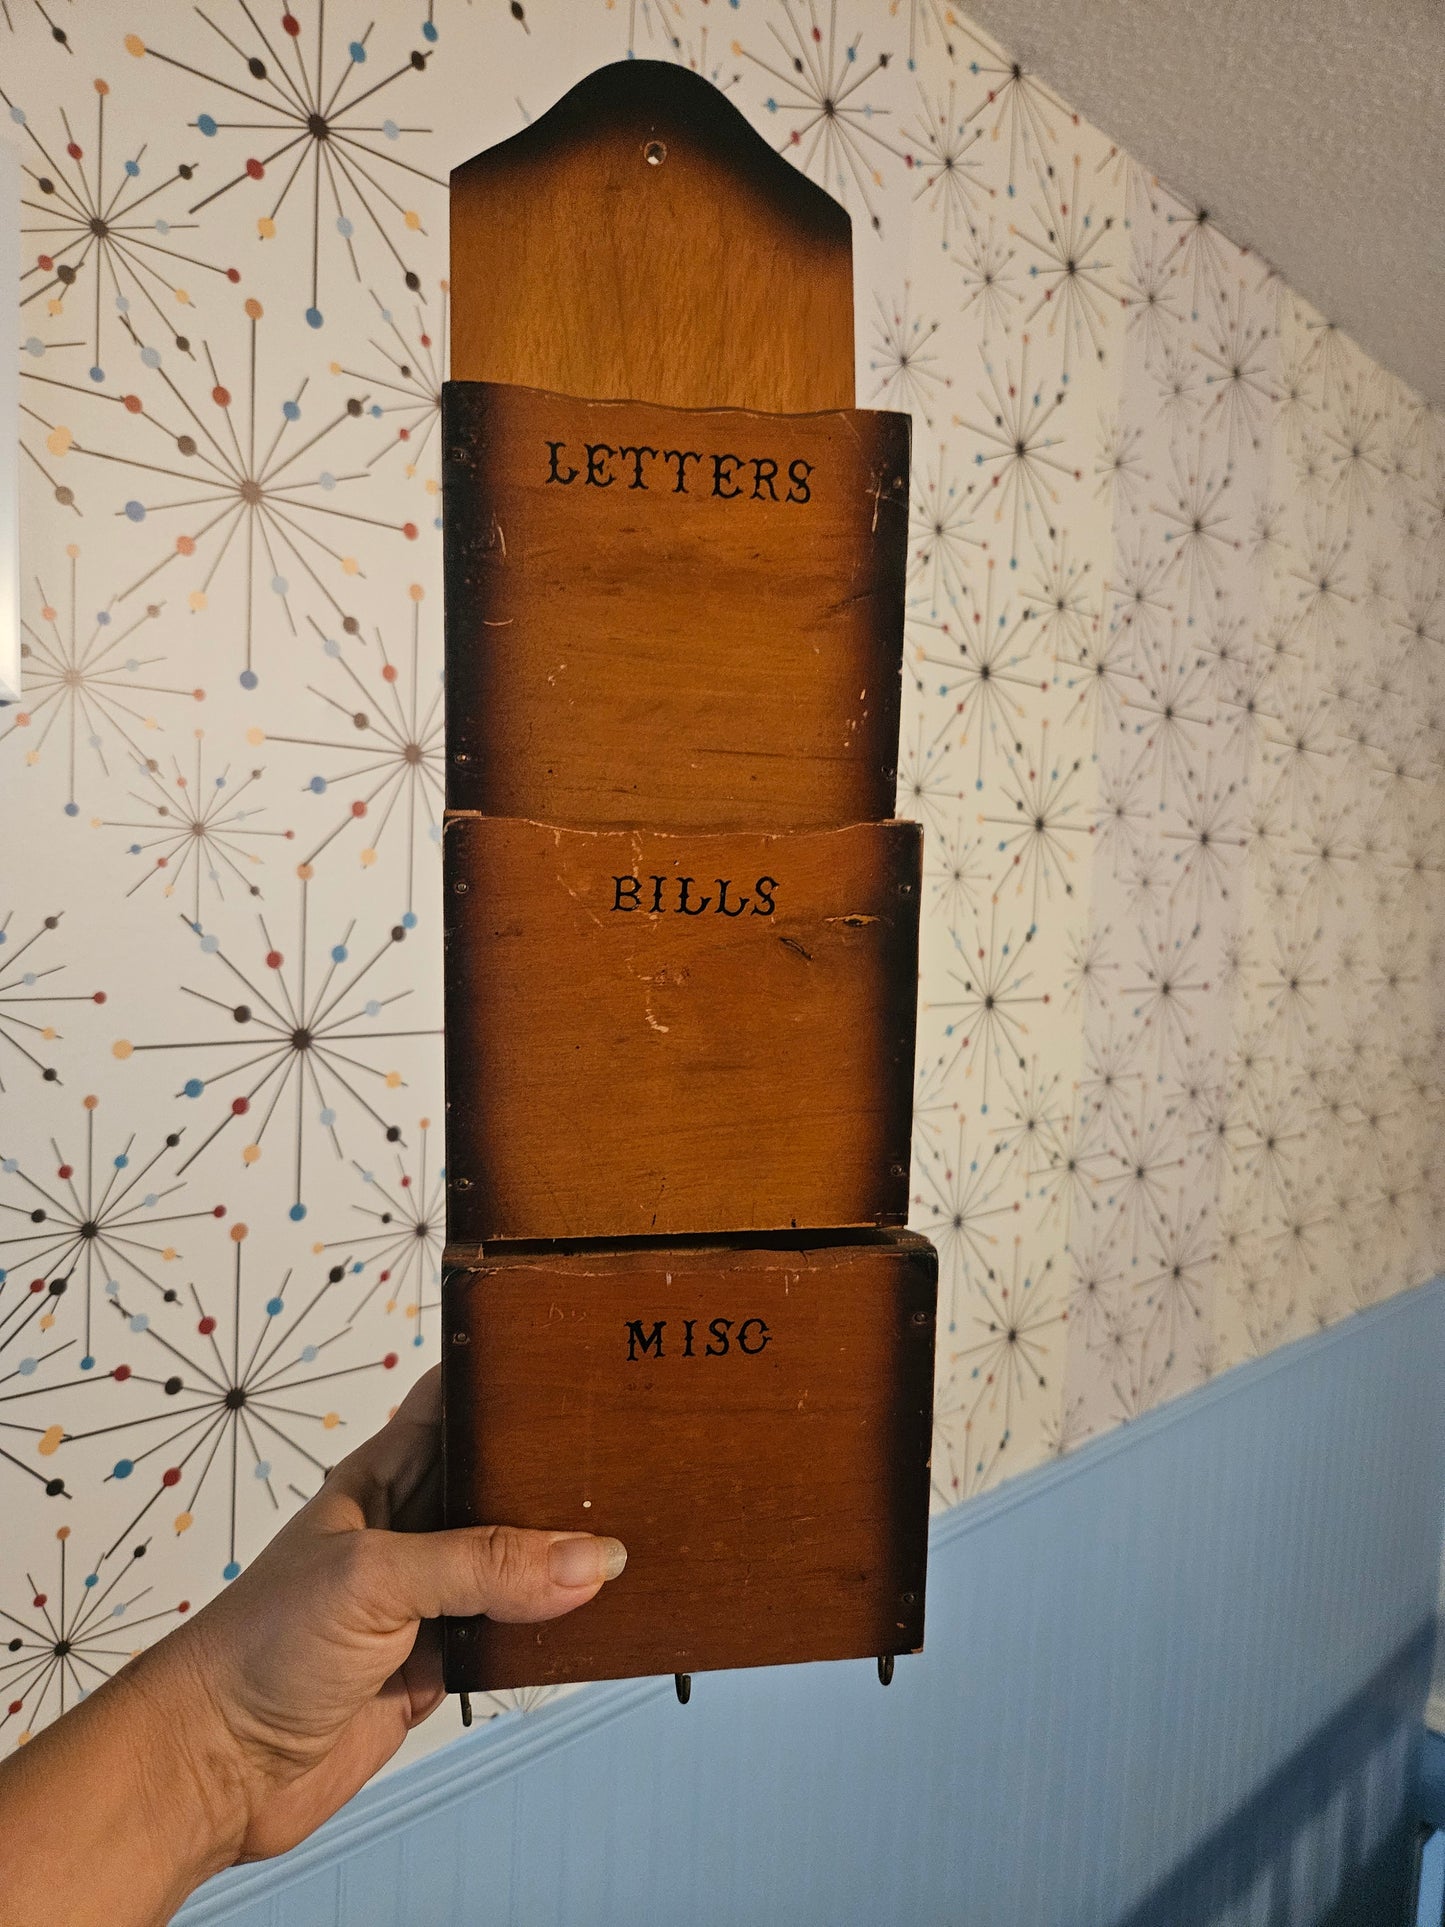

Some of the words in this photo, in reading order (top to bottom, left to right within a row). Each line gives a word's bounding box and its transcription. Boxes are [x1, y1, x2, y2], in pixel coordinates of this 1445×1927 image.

[545, 441, 815, 504] LETTERS
[610, 875, 780, 917] BILLS
[624, 1318, 772, 1361] MISC
